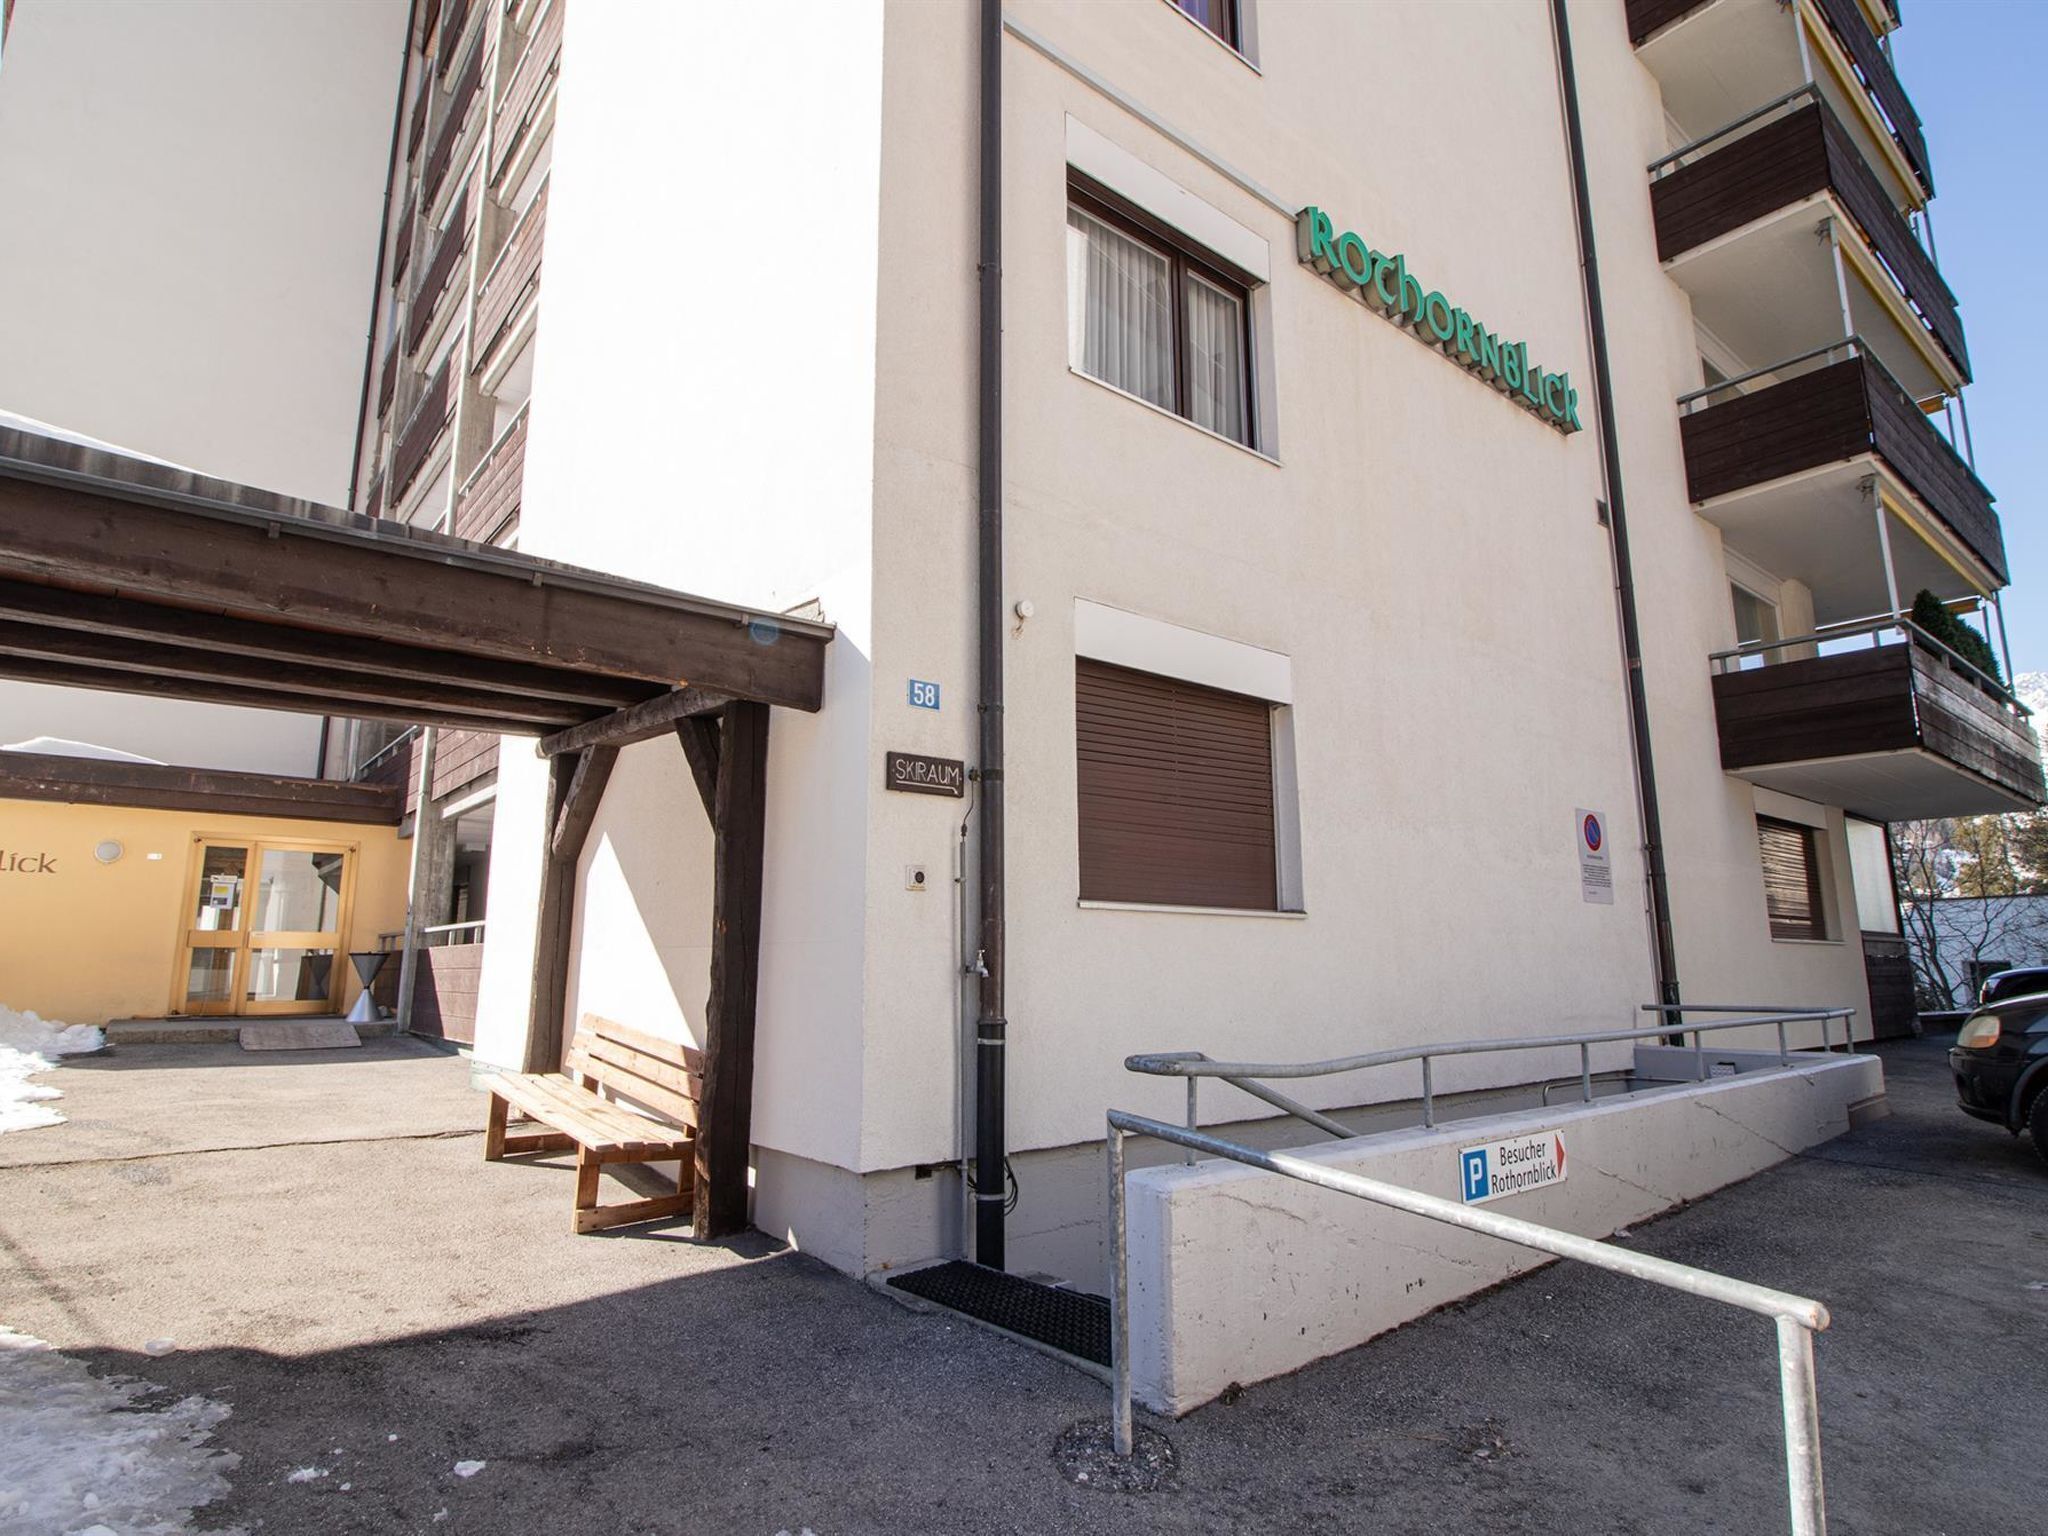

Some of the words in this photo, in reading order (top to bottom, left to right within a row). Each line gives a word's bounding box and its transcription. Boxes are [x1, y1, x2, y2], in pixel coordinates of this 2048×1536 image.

[913, 682, 936, 707] 58
[895, 758, 960, 786] SKIRAUM
[1499, 1141, 1547, 1167] Besucher
[1469, 1157, 1484, 1195] P
[1491, 1159, 1557, 1195] Rothornblick
